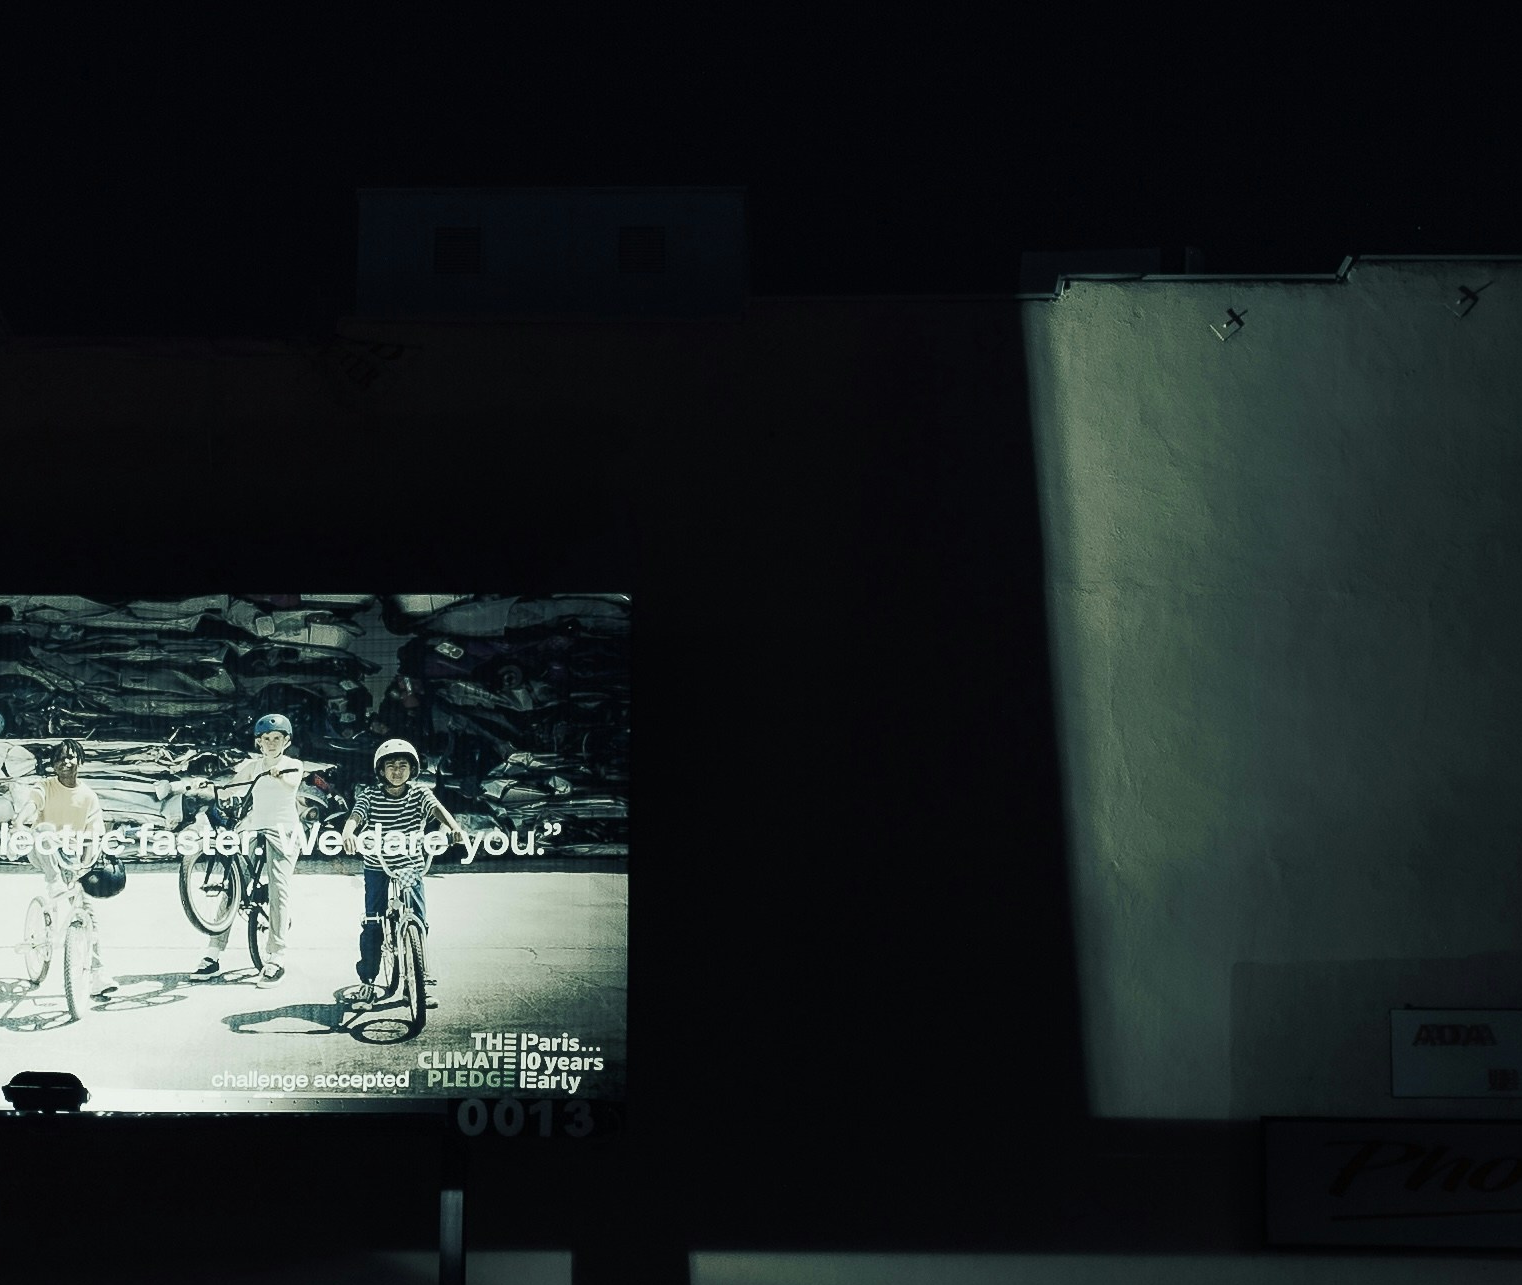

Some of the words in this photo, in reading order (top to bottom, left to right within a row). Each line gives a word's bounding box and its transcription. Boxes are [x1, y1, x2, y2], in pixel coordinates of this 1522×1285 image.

[137, 822, 264, 856] faster.
[278, 822, 343, 856] We
[351, 822, 448, 856] dare
[471, 1032, 517, 1051] THE
[1413, 1024, 1497, 1046] ADA
[417, 1051, 517, 1069] CLIMATE
[520, 1052, 541, 1070] 10
[544, 1054, 605, 1073] years
[211, 1070, 308, 1091] challenge
[313, 1070, 410, 1091] accepted
[427, 1070, 516, 1088] PLEDGE
[520, 1072, 582, 1093] Early
[457, 1099, 595, 1138] 0013
